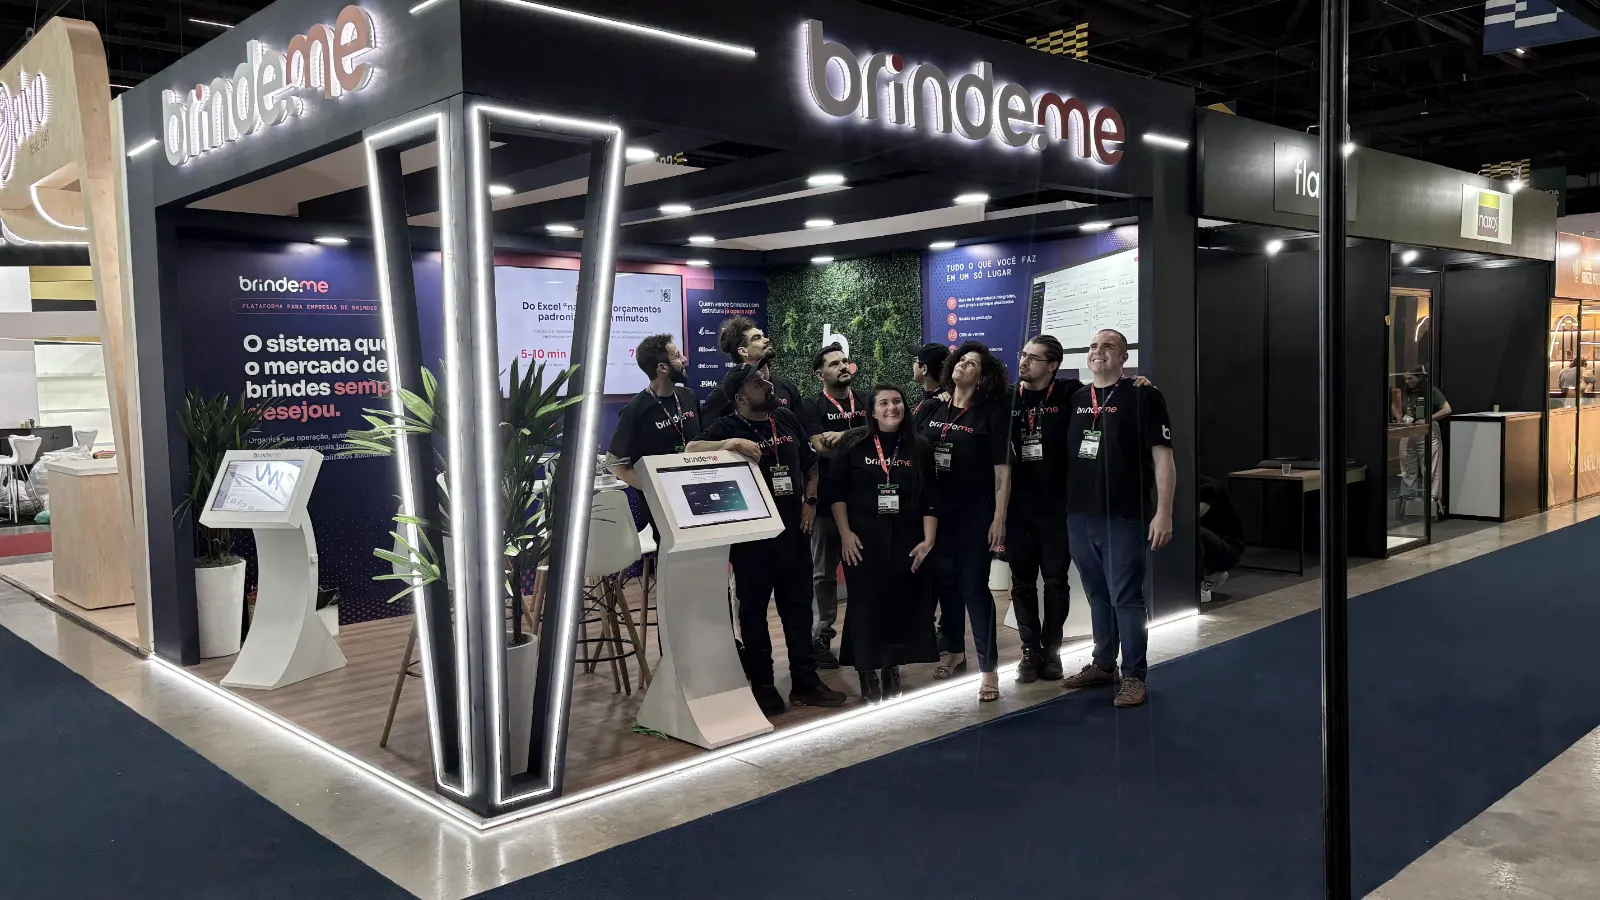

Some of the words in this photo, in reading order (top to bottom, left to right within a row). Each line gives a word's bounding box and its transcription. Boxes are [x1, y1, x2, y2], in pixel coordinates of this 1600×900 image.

[162, 5, 375, 166] brinde.me
[805, 19, 1126, 166] brinde.me
[1295, 159, 1320, 199] fla
[946, 263, 964, 272] TUDO
[968, 262, 974, 270] O
[978, 260, 992, 270] QUE
[997, 256, 1017, 267] VOCÊ
[1021, 255, 1037, 264] FAZ
[946, 274, 956, 282] EM
[960, 273, 969, 281] UM
[973, 270, 983, 280] SÓ
[988, 269, 1012, 278] LUGAR
[239, 276, 329, 294] brinde.me
[522, 301, 536, 311] Do
[537, 302, 561, 311] Excel
[613, 305, 662, 316] orçamentos
[698, 300, 715, 308] Quem
[538, 313, 575, 323] padroni
[616, 314, 649, 323] minutos
[243, 334, 263, 353] O
[266, 334, 352, 353] sistema
[521, 349, 545, 359] 5-10
[547, 349, 567, 359] min
[244, 361, 260, 376] o
[264, 357, 360, 375] mercado
[362, 356, 389, 373] de
[246, 379, 331, 399] brindes
[334, 380, 391, 398] semp
[296, 433, 331, 443] operação,
[683, 455, 719, 464] brinde.me
